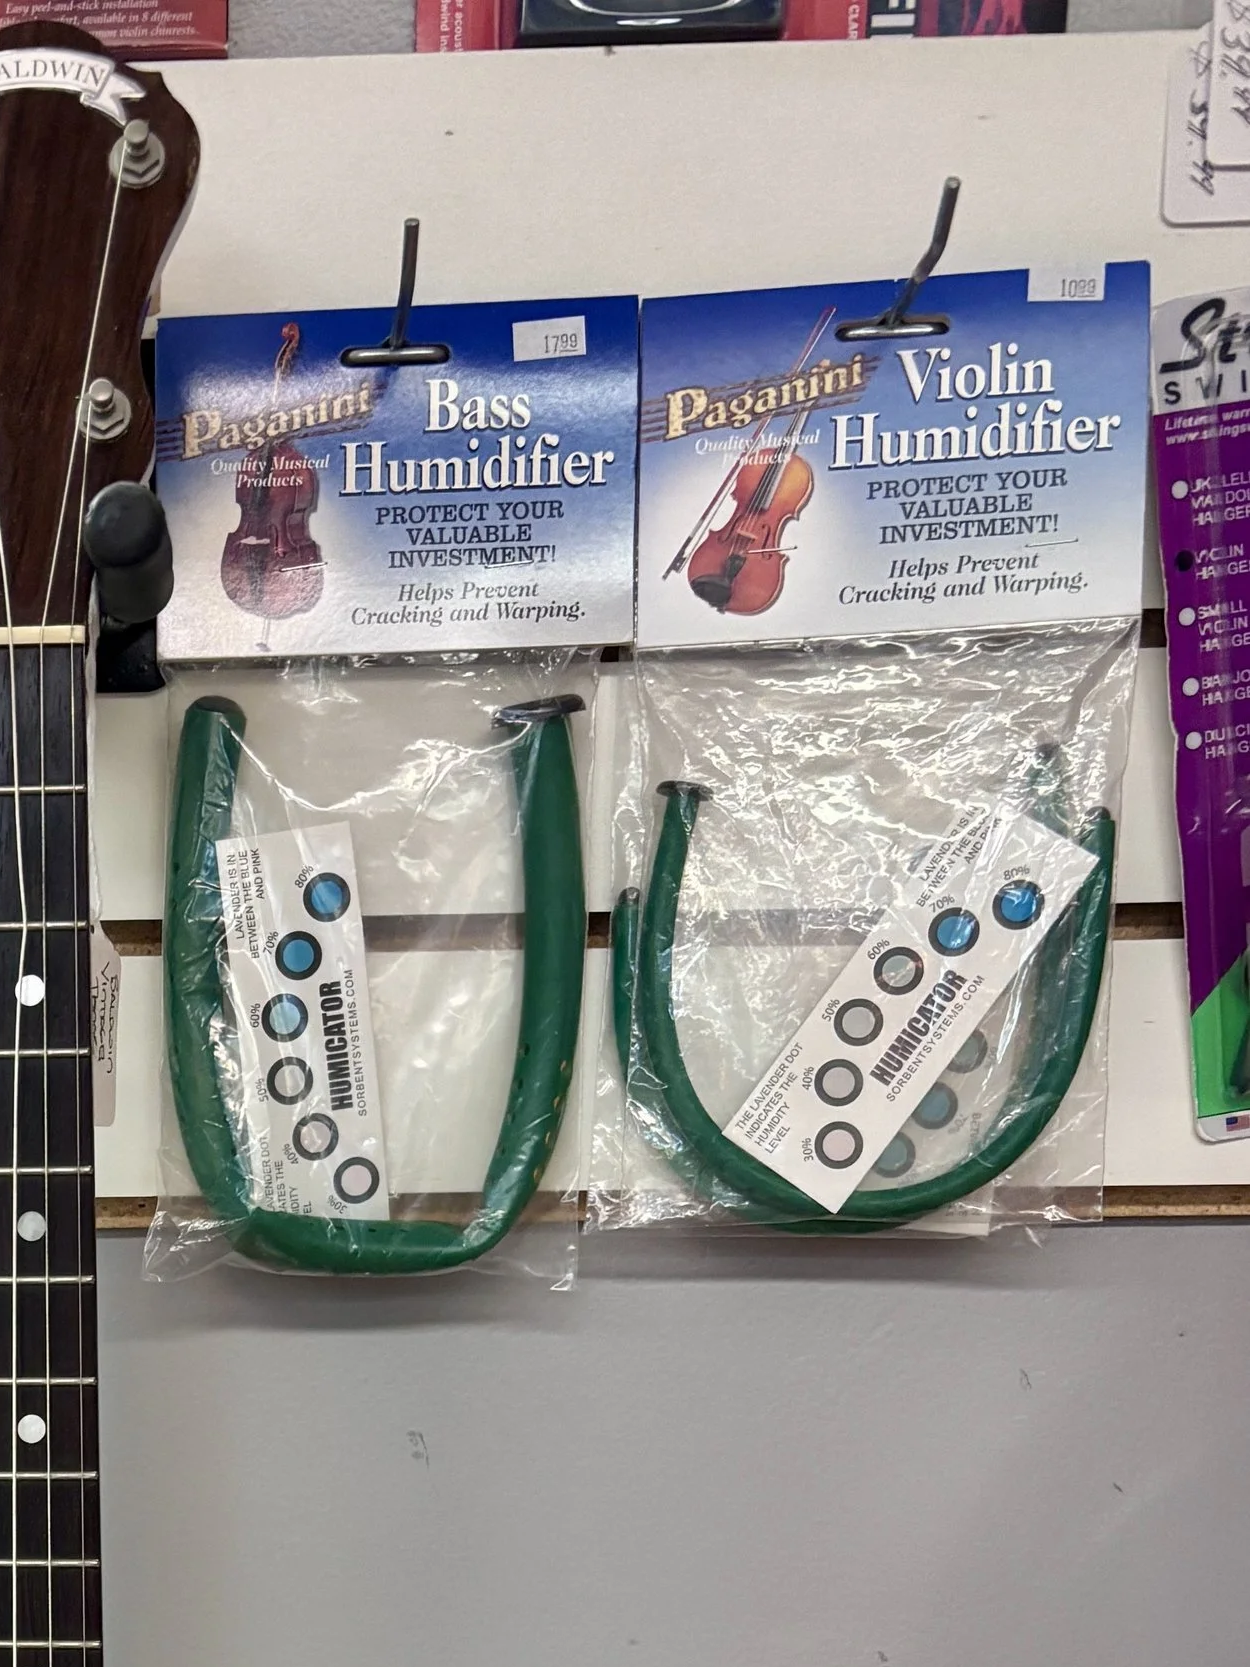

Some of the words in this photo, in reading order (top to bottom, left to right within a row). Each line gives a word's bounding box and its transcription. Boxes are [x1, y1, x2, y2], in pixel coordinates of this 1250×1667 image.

[897, 343, 1055, 403] Violin
[424, 378, 531, 433] Bass
[663, 353, 864, 441] Paganini
[182, 382, 373, 460] Paganini
[828, 399, 1121, 470] Humidifier
[695, 433, 753, 454] Quality
[757, 429, 820, 446] Musical
[211, 456, 268, 476] Quality
[271, 454, 330, 470] Musical
[340, 433, 615, 496] Humidifier
[237, 473, 303, 488] Products
[866, 473, 988, 500] PROTECT
[996, 468, 1068, 490] YOUR
[375, 503, 490, 525] PROTECT
[496, 500, 564, 520] YOUR
[900, 493, 1033, 520] VALUABLE
[406, 524, 532, 546] VALUABLE
[879, 513, 1059, 544] INVESTMENT!
[388, 545, 556, 569] INVESTMENT!
[888, 557, 949, 580] Helps
[955, 552, 1040, 575] Prevent
[398, 582, 454, 604] Helps
[461, 582, 539, 600] Prevent
[838, 582, 936, 605] Cracking
[943, 576, 985, 597] and
[993, 571, 1089, 595] Warping.
[351, 605, 443, 627] Cracking
[450, 603, 489, 621] and
[496, 600, 586, 623] Warping.
[226, 854, 236, 866] IN
[250, 848, 262, 873] PINK
[920, 829, 961, 881] LAVENDR
[957, 817, 969, 830] IS
[951, 837, 971, 859] THE
[963, 842, 983, 864] AND
[228, 869, 237, 879] IS
[238, 850, 250, 879] BLUE
[242, 881, 253, 903] THE
[254, 876, 265, 899] AND
[230, 881, 245, 939] LAVENDER
[929, 894, 955, 913] 70%
[245, 906, 260, 959] BETWEEN
[263, 931, 279, 955] 70%
[867, 939, 891, 960] 60%
[250, 1003, 261, 1028] 60%
[822, 999, 841, 1022] 50%
[869, 970, 967, 1087] HUMICATOR
[886, 975, 985, 1102] SORBENTSYSTEMS.COM
[319, 980, 354, 1111] HUMICATOR
[344, 969, 367, 1117] SORBENTSYSTEMS.COM
[735, 1110, 754, 1130] THE
[750, 1063, 789, 1111] LAVENDER
[785, 1042, 803, 1064] DOT
[802, 1066, 815, 1090] 40%
[745, 1091, 784, 1140] INDICATES
[779, 1072, 798, 1092] THE
[754, 1101, 790, 1147] HUMIDITY
[765, 1126, 791, 1154] LEVEL
[802, 1137, 813, 1162] 30%
[284, 1143, 299, 1165] 40%
[275, 1160, 284, 1181] THE
[289, 1186, 300, 1214] IDITY
